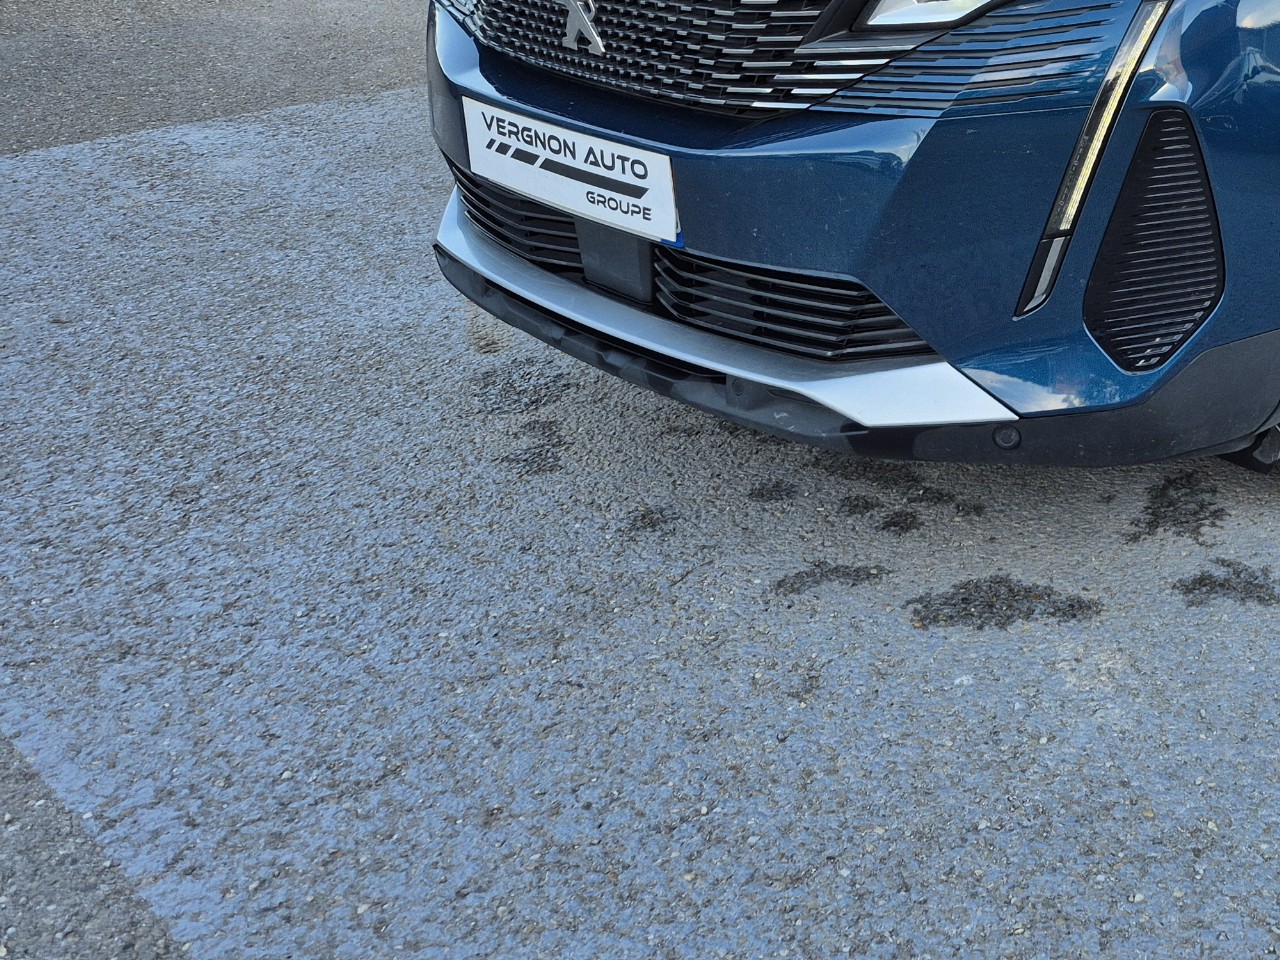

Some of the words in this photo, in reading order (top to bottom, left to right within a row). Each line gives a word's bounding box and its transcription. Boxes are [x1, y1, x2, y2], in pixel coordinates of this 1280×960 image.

[481, 111, 577, 161] VERGNON
[583, 146, 649, 180] AUTO
[585, 190, 652, 221] GROUPE
